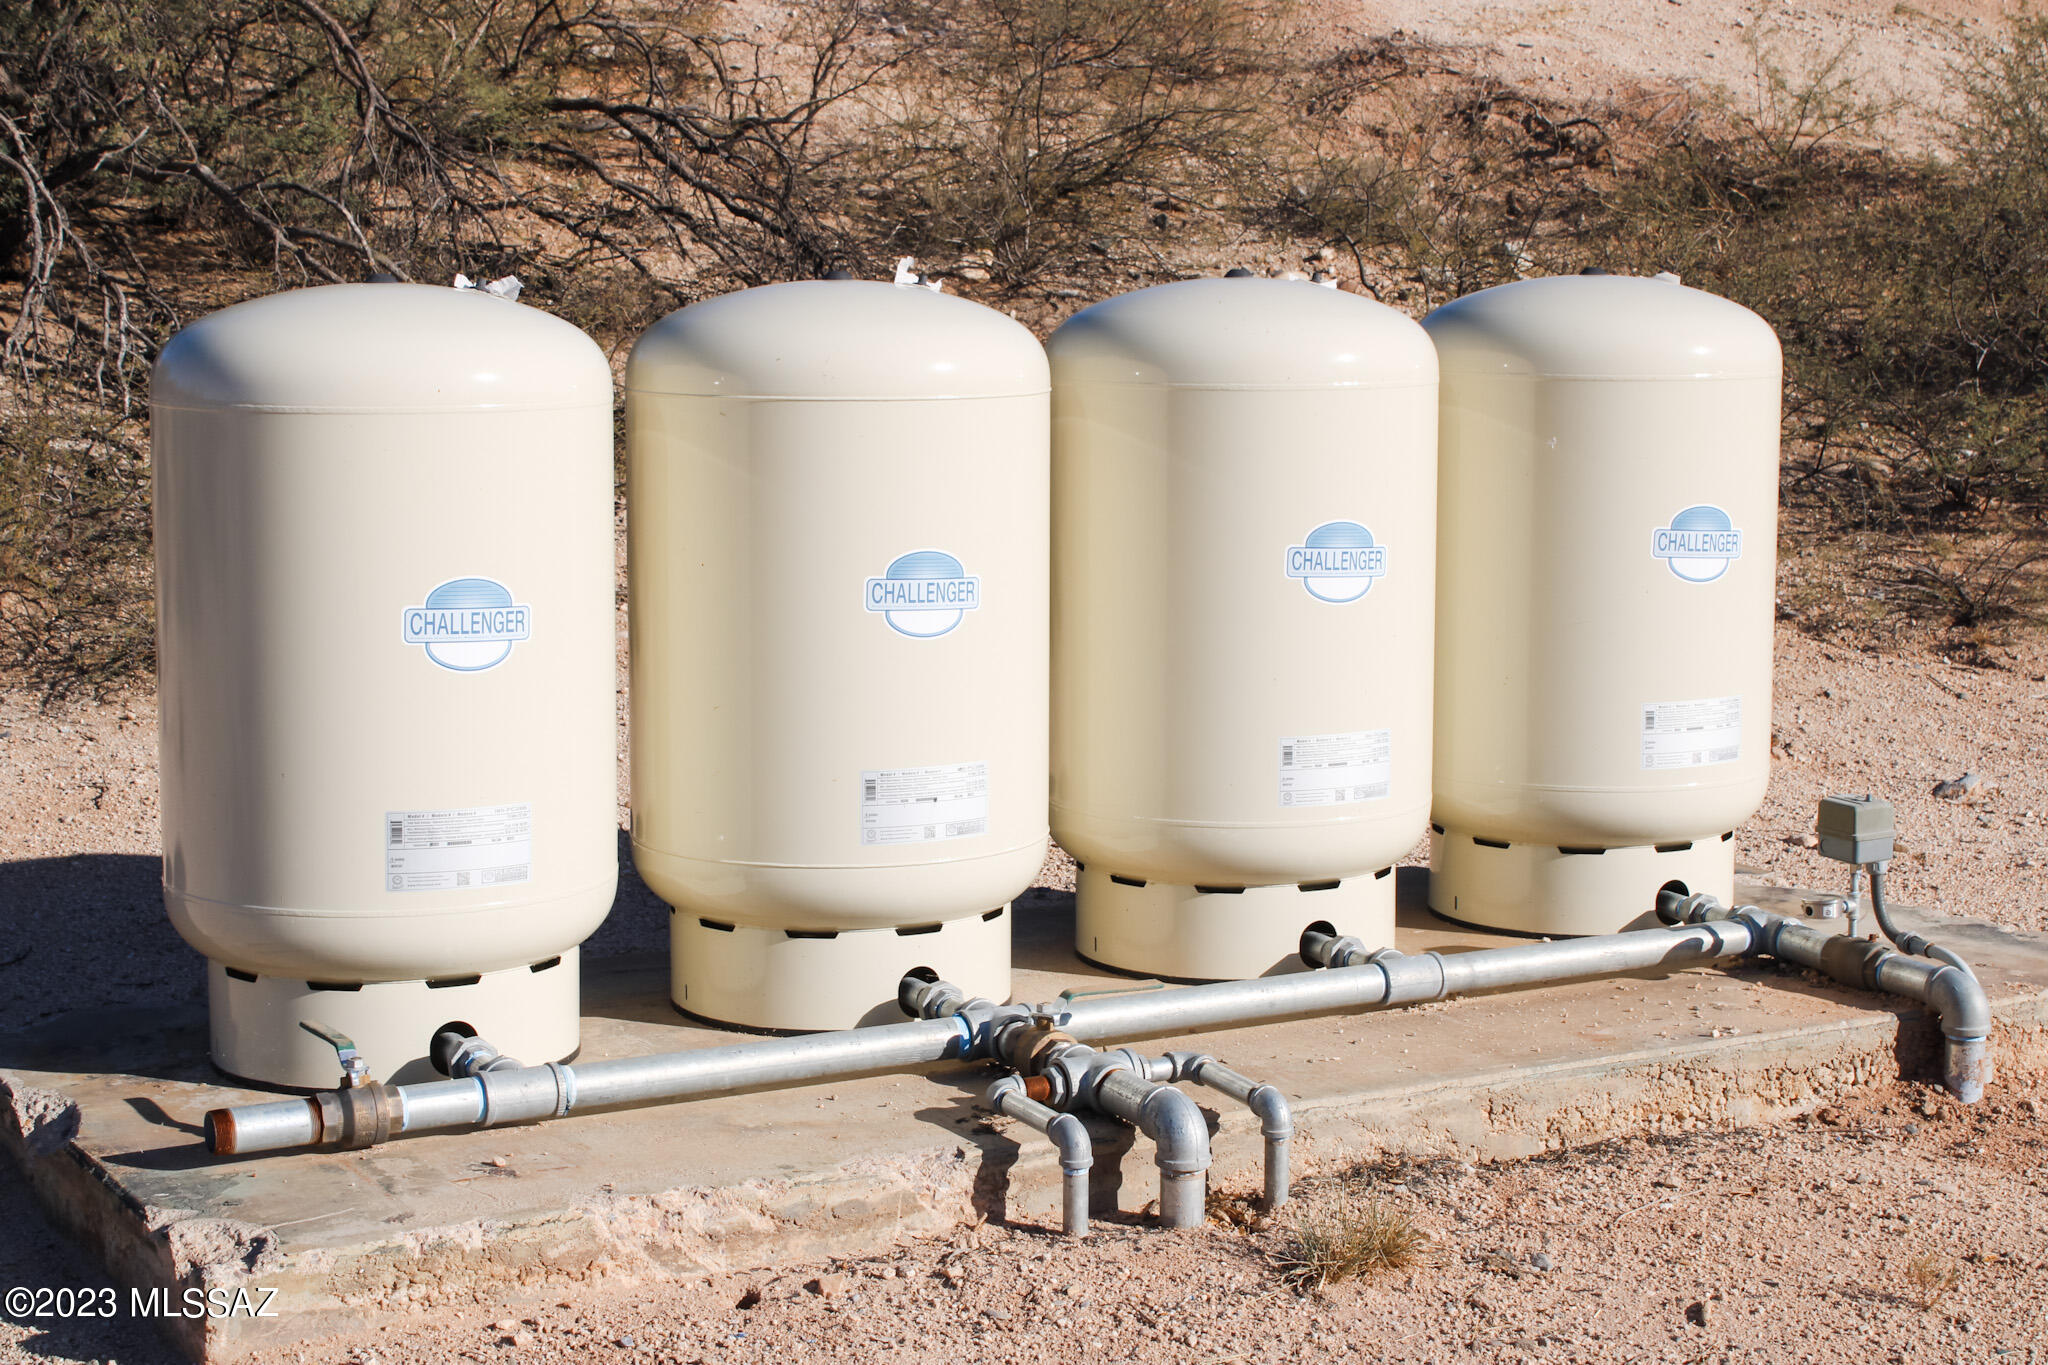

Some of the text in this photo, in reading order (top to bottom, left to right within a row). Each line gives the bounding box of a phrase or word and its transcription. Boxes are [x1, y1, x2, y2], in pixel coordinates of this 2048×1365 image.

[1658, 532, 1738, 552] CHALLENGER
[1291, 550, 1383, 571] CHALLENGER
[871, 581, 975, 604] CHALLENGER
[410, 610, 525, 635] CHALLENGER
